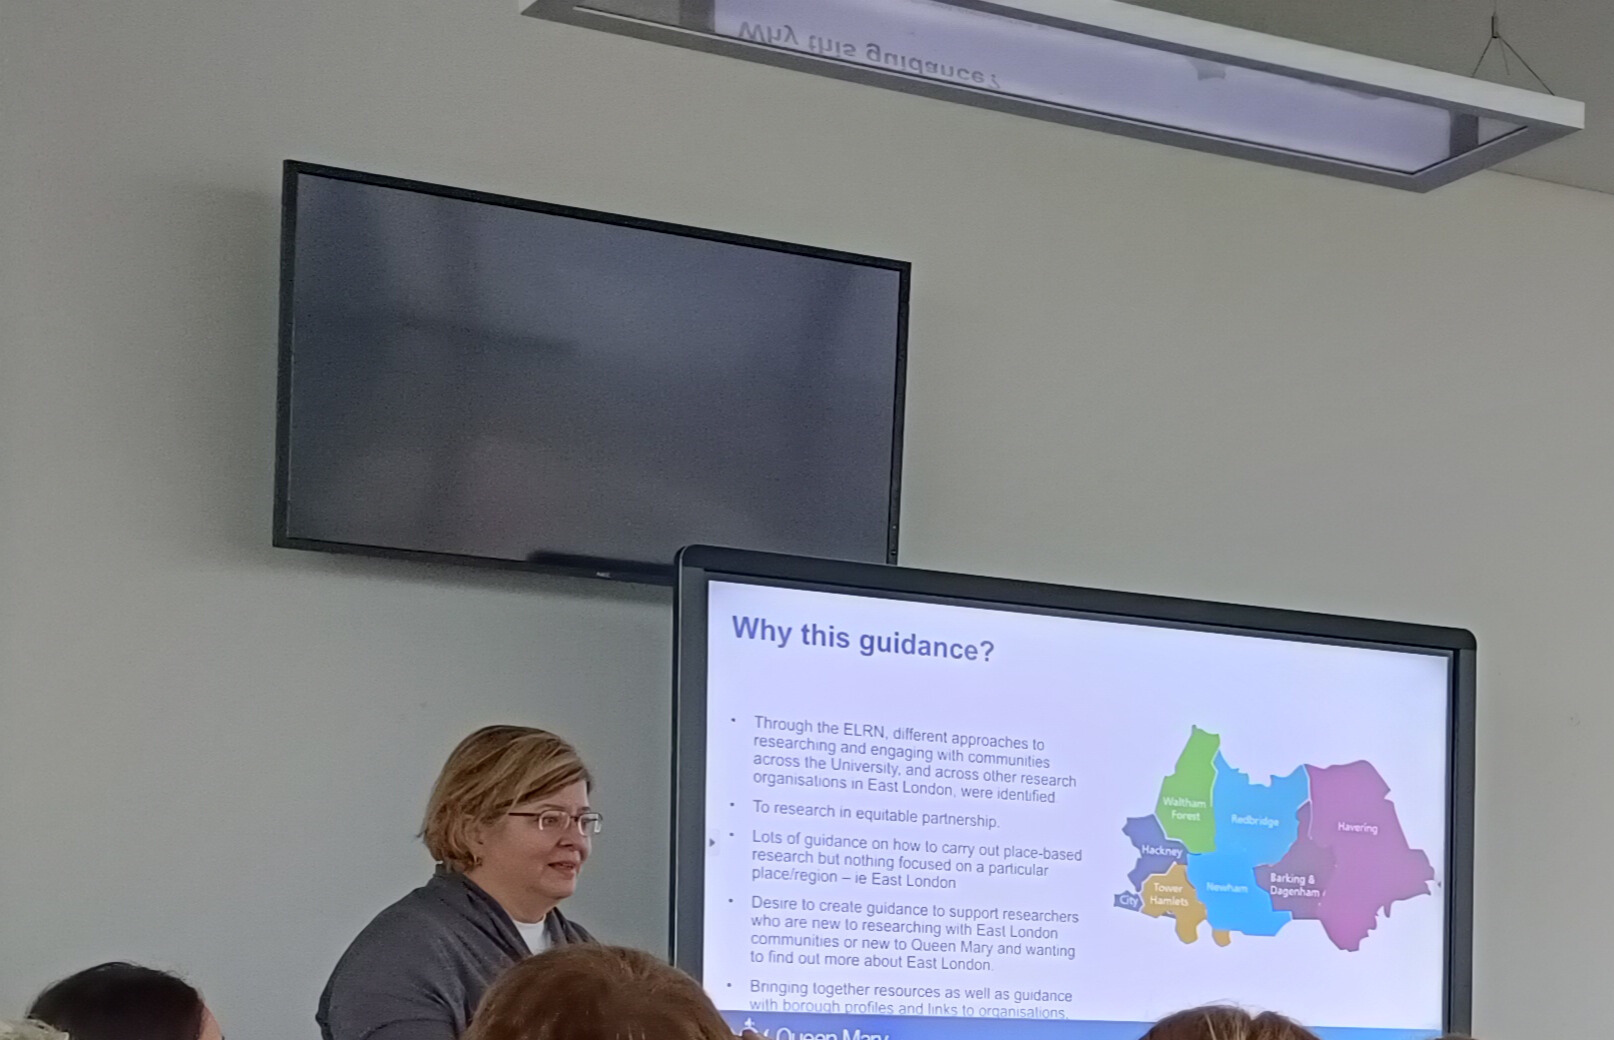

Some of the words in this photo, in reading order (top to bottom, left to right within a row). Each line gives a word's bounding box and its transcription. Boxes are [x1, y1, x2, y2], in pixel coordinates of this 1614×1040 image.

[731, 615, 793, 648] Why
[800, 623, 851, 648] this
[859, 631, 995, 661] guidance?
[754, 716, 814, 736] Through
[816, 721, 840, 735] the
[843, 723, 889, 741] ELRN,
[892, 727, 948, 743] different
[951, 735, 1029, 750] approaches
[1032, 739, 1045, 751] to
[753, 736, 837, 756] researching
[839, 743, 867, 755] and
[869, 745, 934, 763] engaging
[936, 749, 965, 762] with
[967, 753, 1051, 768] communities
[752, 756, 801, 768] across
[803, 756, 828, 770] the
[830, 758, 902, 779] University,
[905, 765, 932, 777] and
[934, 768, 980, 780] across
[982, 770, 1018, 783] other
[1020, 774, 1077, 787] research
[752, 773, 848, 789] organisations
[850, 780, 864, 791] in
[867, 778, 899, 793] East
[902, 781, 957, 798] London,
[960, 788, 994, 799] were
[996, 788, 1056, 803] identified
[1163, 797, 1207, 809] Waltham
[752, 801, 771, 814] To
[773, 805, 836, 818] research
[839, 809, 852, 819] in
[855, 809, 919, 824] equitable
[921, 813, 1001, 831] partnership.
[1171, 809, 1201, 821] Forest
[1231, 814, 1280, 828] Redbridge
[1338, 821, 1379, 835] Havering
[752, 830, 783, 844] Lots
[786, 832, 801, 845] of
[803, 834, 868, 850] guidance
[871, 840, 889, 851] on
[892, 838, 922, 852] how
[924, 841, 939, 853] to
[941, 844, 976, 859] carry
[978, 845, 1001, 857] out
[1003, 846, 1083, 862] place-based
[1142, 845, 1183, 858] Hackney
[751, 851, 814, 865] research
[817, 852, 841, 866] but
[843, 854, 895, 872] nothing
[898, 856, 952, 871] focused
[955, 862, 973, 872] on
[975, 864, 985, 873] a
[988, 863, 1050, 877] particular
[751, 867, 838, 886] place/region
[854, 874, 868, 885] ie
[871, 872, 903, 886] East
[906, 874, 957, 888] London
[1270, 873, 1305, 886] Barking
[1308, 874, 1316, 884] &
[1153, 883, 1183, 894] Tower
[1206, 882, 1249, 894] Newham
[1270, 885, 1320, 899] Dagenham
[751, 897, 798, 911] Desire
[801, 899, 816, 912] to
[818, 901, 863, 914] create
[866, 902, 929, 918] guidance
[932, 905, 946, 918] to
[948, 908, 1000, 924] support
[1002, 910, 1080, 924] researchers
[1119, 896, 1138, 908] City
[1150, 895, 1189, 907] Hamlets
[750, 915, 782, 929] who
[783, 919, 808, 930] are
[811, 920, 842, 930] new
[844, 919, 859, 932] to
[861, 921, 942, 938] researching
[944, 923, 973, 936] with
[976, 924, 1007, 937] East
[1009, 925, 1059, 939] London
[750, 934, 840, 949] communities
[843, 940, 859, 950] or
[861, 941, 891, 951] new
[893, 939, 908, 952] to
[910, 939, 957, 954] Queen
[960, 941, 994, 958] Mary
[996, 944, 1022, 956] and
[1024, 945, 1076, 961] wanting
[749, 951, 765, 963] to
[767, 952, 795, 964] find
[797, 953, 821, 965] out
[824, 957, 861, 967] more
[863, 955, 903, 969] about
[906, 956, 938, 970] East
[940, 957, 994, 971] London.
[749, 981, 809, 999] Bringing
[812, 983, 871, 1001] together
[873, 988, 941, 999] resources
[944, 990, 961, 1000] as
[964, 987, 991, 1000] well
[994, 991, 1011, 1001] as
[1013, 990, 1073, 1004] guidance
[750, 999, 778, 1012] with
[783, 1000, 839, 1013] borough
[845, 1001, 894, 1015] profiles
[899, 1003, 923, 1015] and
[928, 1003, 958, 1016] links
[962, 1005, 974, 1016] to
